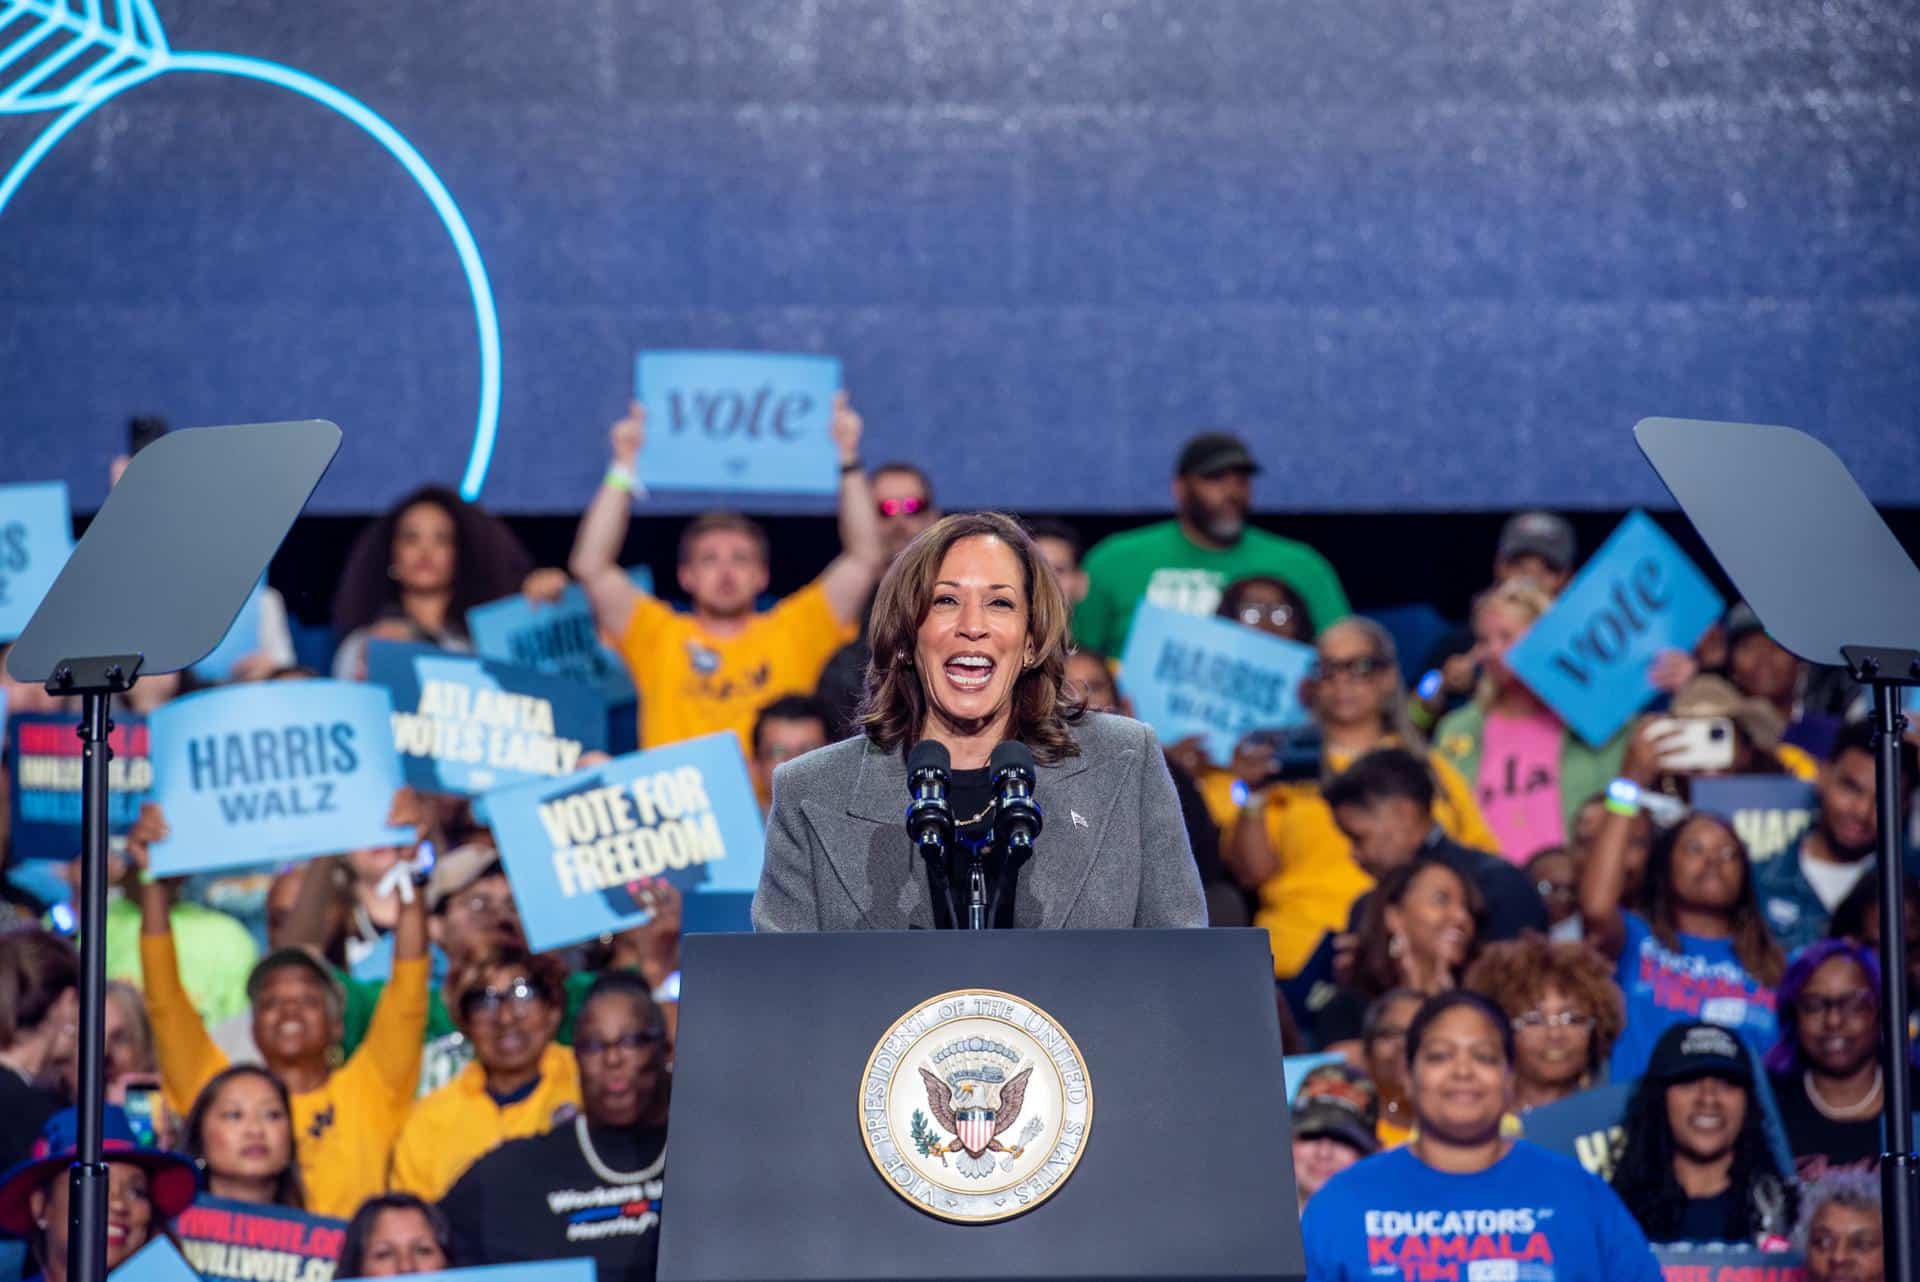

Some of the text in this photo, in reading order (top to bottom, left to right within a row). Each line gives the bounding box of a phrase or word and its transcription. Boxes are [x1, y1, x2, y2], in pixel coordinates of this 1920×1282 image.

[666, 379, 814, 442] vote
[1553, 555, 1666, 688] vote
[419, 681, 556, 736] ATLANTA
[187, 722, 359, 793] HARRIS
[390, 711, 582, 777] VOTES EARLY
[218, 783, 339, 825] WALZ
[538, 765, 710, 850] VOTE FOR
[550, 813, 727, 898] FREEDOM
[938, 1000, 965, 1018] OF
[973, 998, 1016, 1020] THE
[865, 1012, 928, 1146] PRESIDENT
[1023, 1011, 1088, 1105] UNITED
[882, 1154, 936, 1207] VICE
[1013, 1119, 1084, 1206] STATES
[1364, 1208, 1537, 1236] EDUCATORS
[1368, 1232, 1554, 1266] KAMALA
